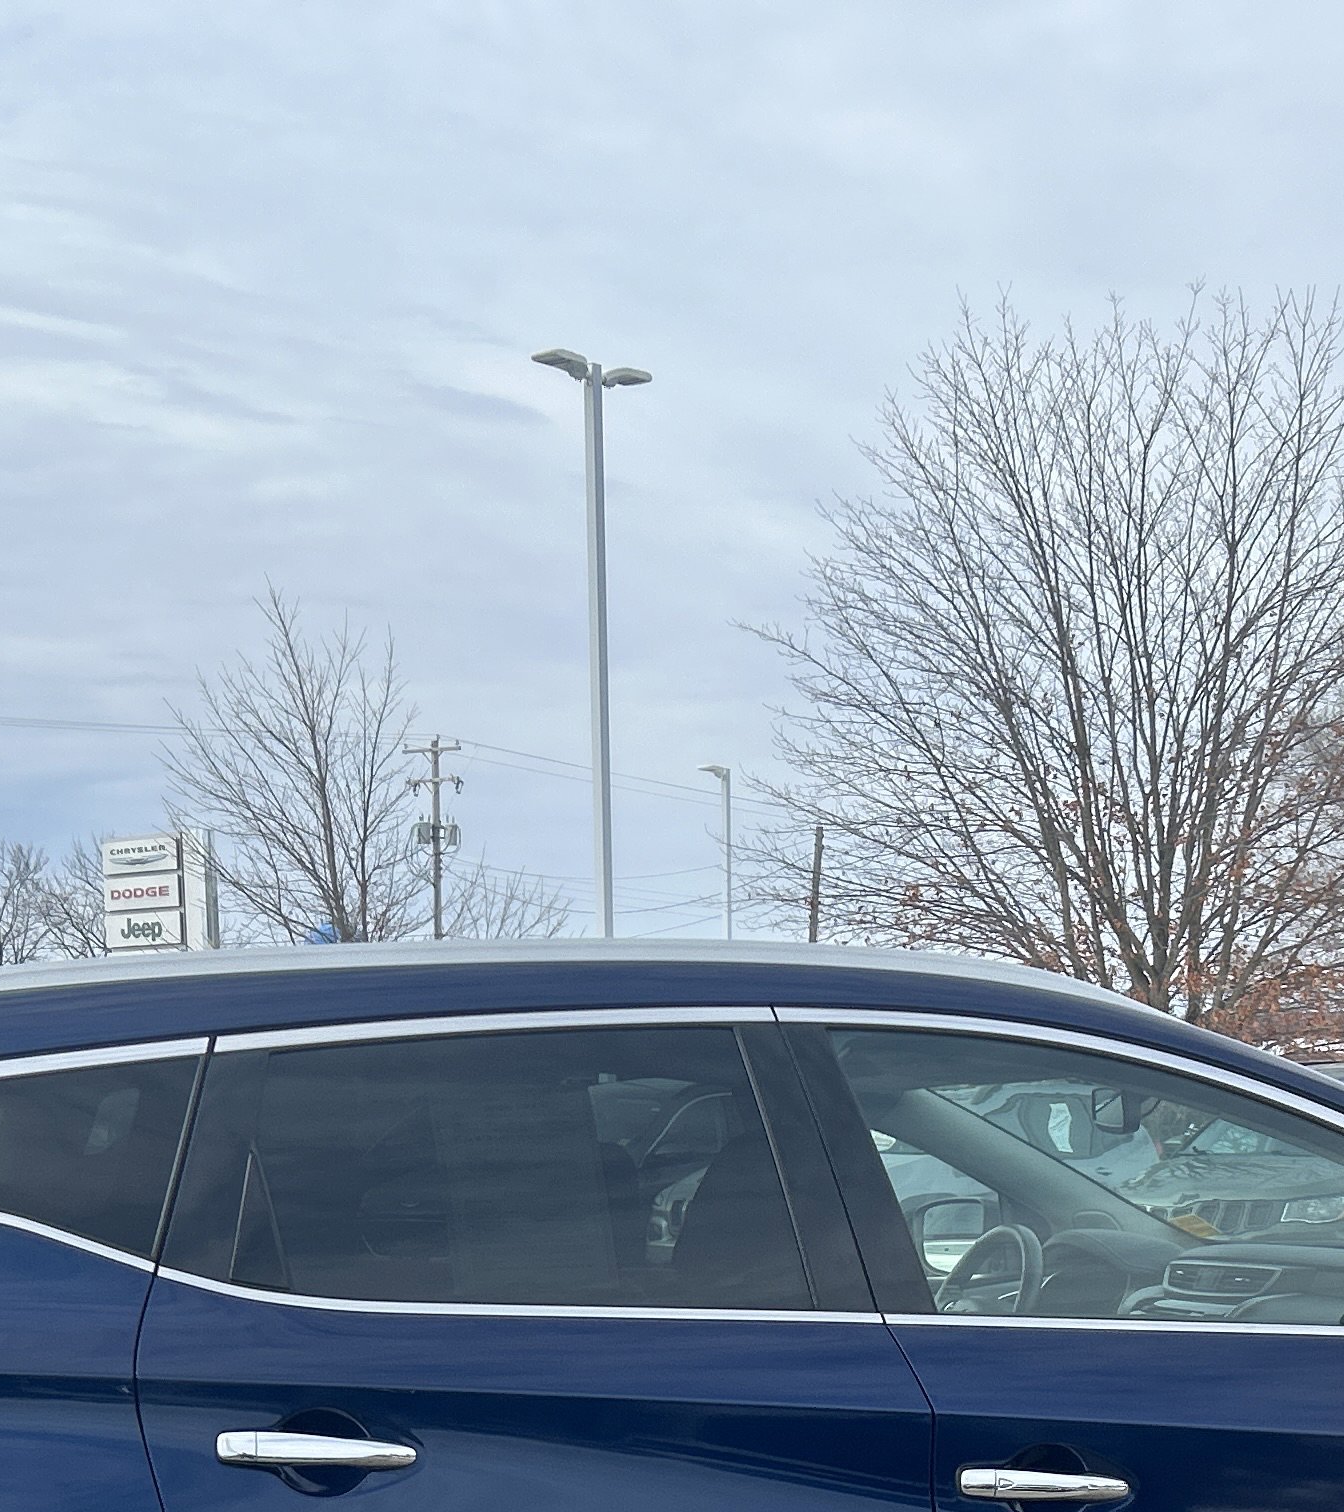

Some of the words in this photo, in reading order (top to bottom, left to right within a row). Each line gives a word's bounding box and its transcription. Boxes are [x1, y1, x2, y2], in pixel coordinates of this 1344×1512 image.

[109, 844, 166, 856] CHRYSLER
[110, 885, 169, 900] DODGE
[121, 918, 163, 941] Jeep
